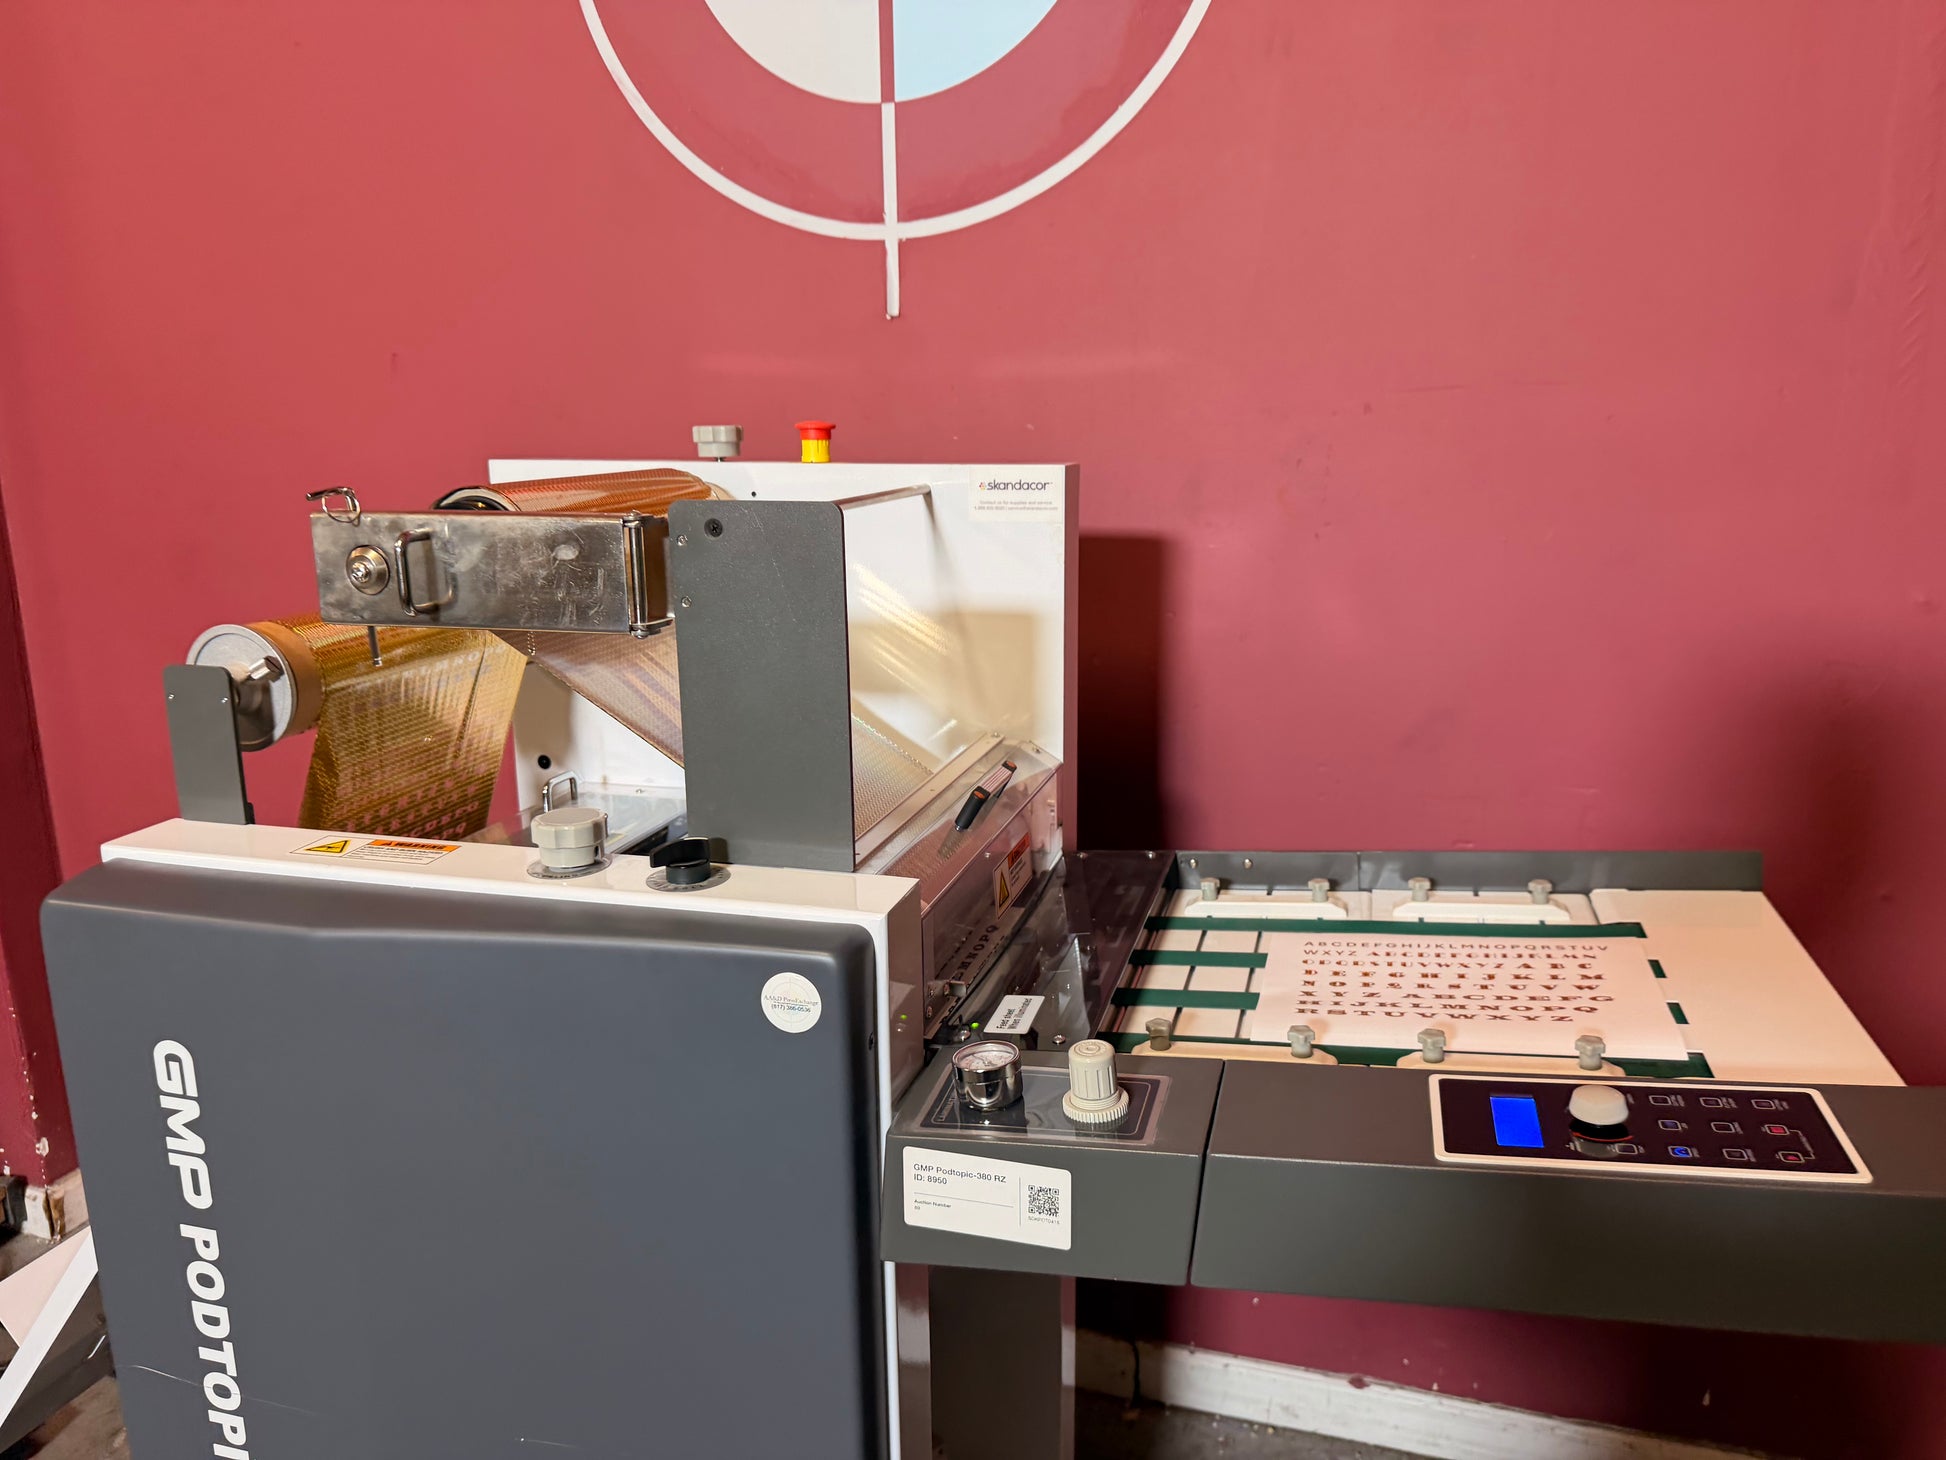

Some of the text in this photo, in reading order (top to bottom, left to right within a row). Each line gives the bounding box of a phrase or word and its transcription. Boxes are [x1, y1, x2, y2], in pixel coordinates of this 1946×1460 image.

[987, 478, 1050, 491] skandacor
[153, 1039, 213, 1210] GMP
[913, 1163, 1007, 1184] GMP Podtopic-380 RZ
[913, 1173, 948, 1185] ID: 8950
